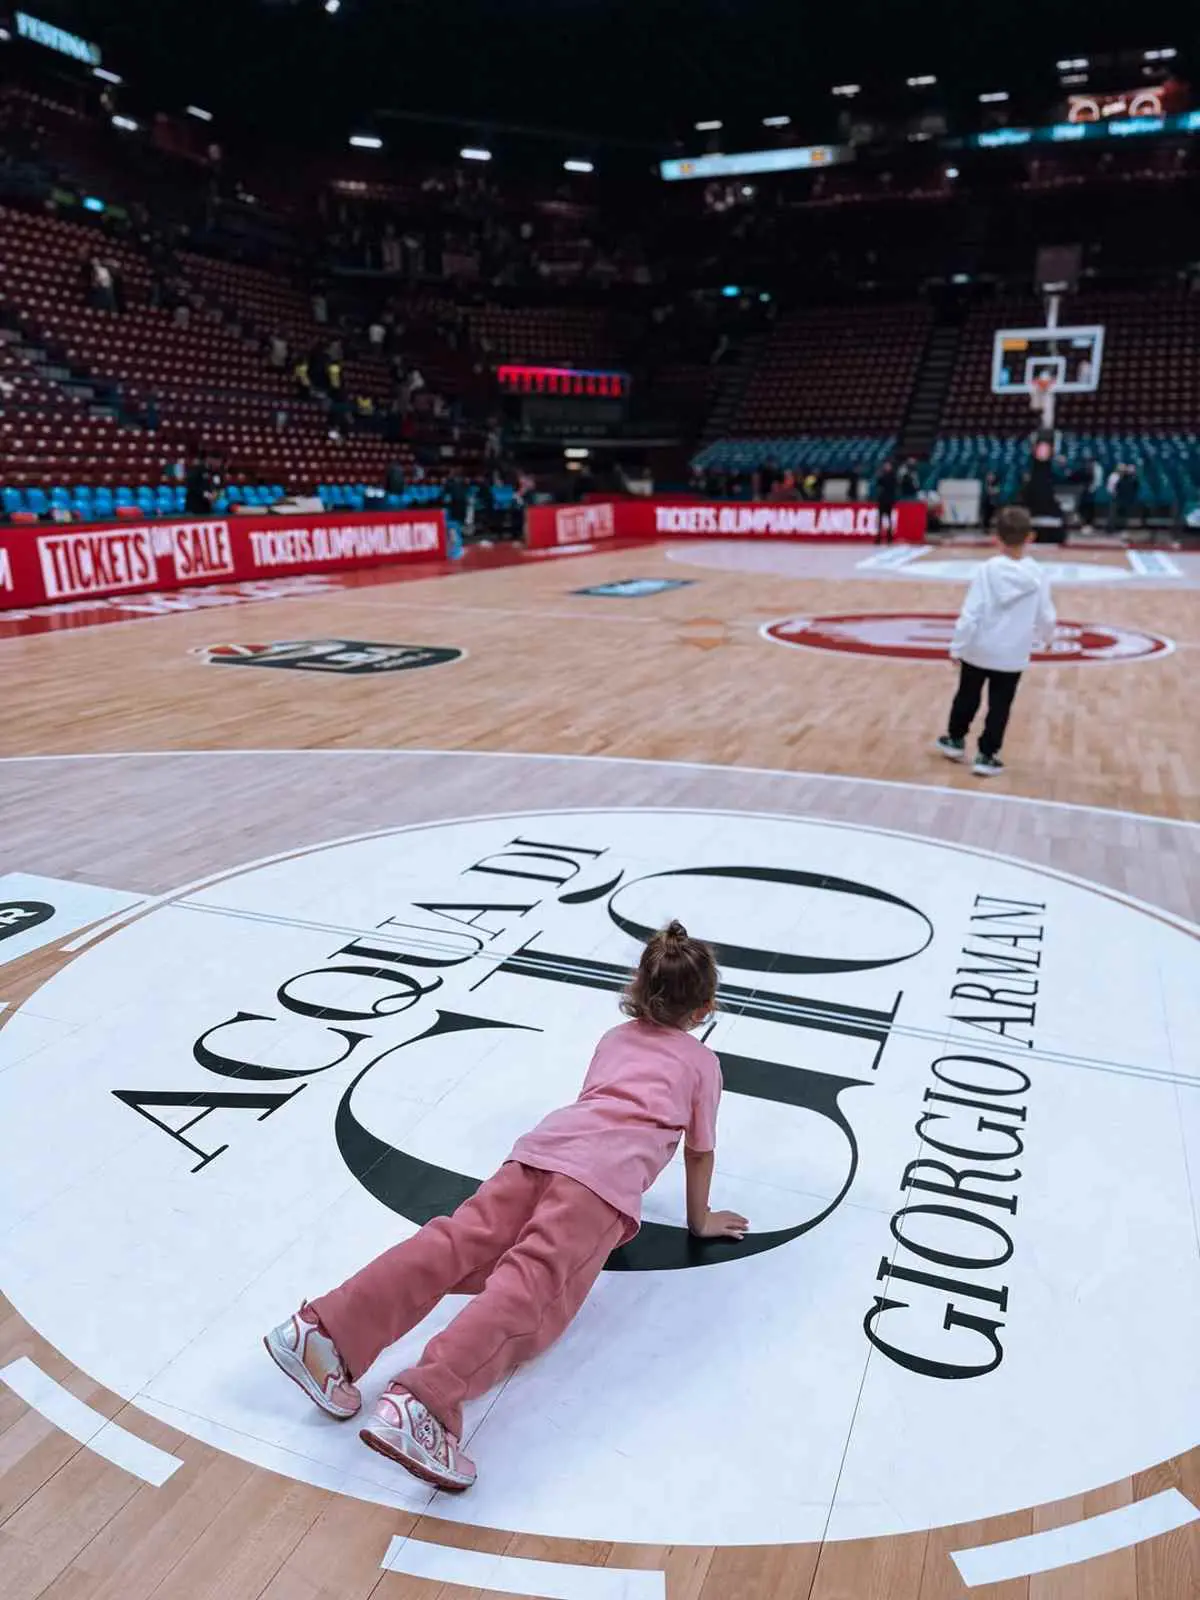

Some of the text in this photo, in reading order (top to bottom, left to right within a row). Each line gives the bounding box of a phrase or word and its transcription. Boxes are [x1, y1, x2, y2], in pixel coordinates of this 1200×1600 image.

[45, 533, 149, 592] TICKETS
[177, 526, 229, 574] SALE
[111, 836, 609, 1173] ACQUA DI
[863, 894, 1047, 1380] GIORGIO ARMANI
